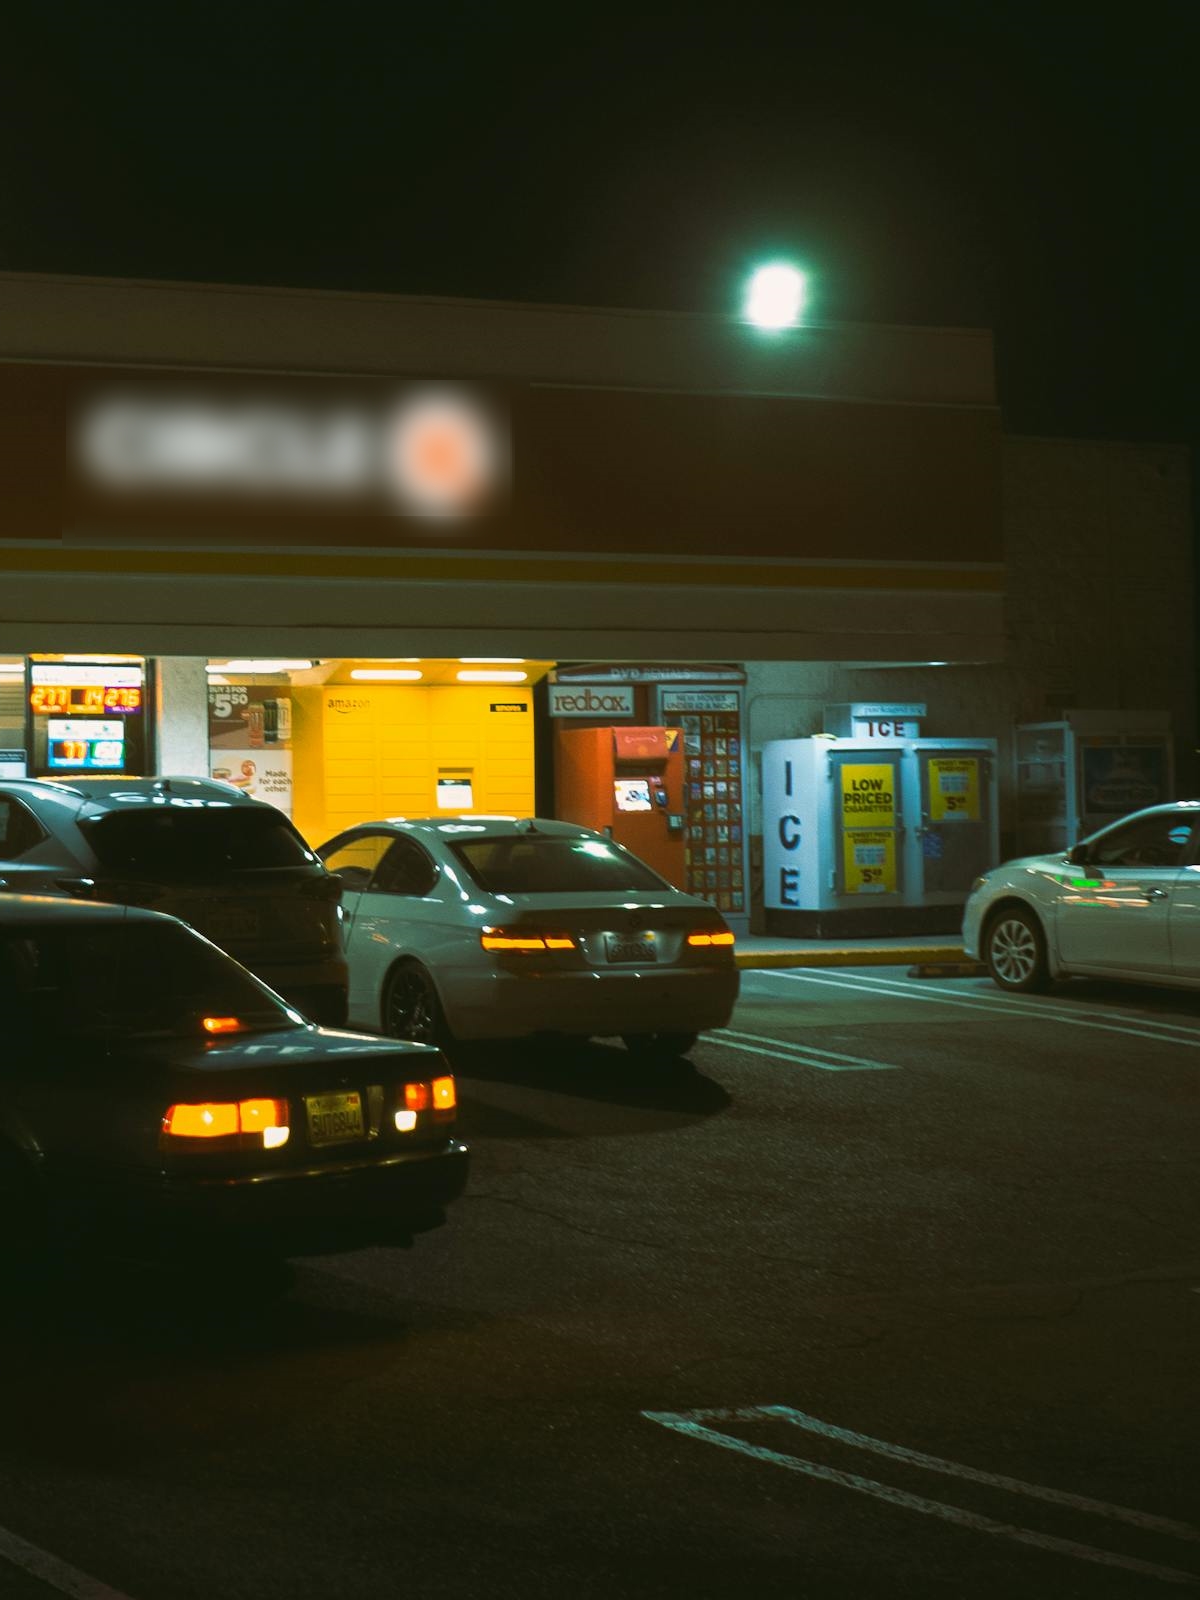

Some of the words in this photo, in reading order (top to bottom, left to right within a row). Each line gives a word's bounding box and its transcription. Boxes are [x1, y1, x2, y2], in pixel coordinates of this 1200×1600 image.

[328, 699, 370, 708] amazon
[868, 721, 905, 737] ICE
[852, 779, 883, 792] LOW
[844, 793, 893, 805] PRICED
[843, 806, 893, 814] CIGARETTES
[778, 760, 801, 907] ICE
